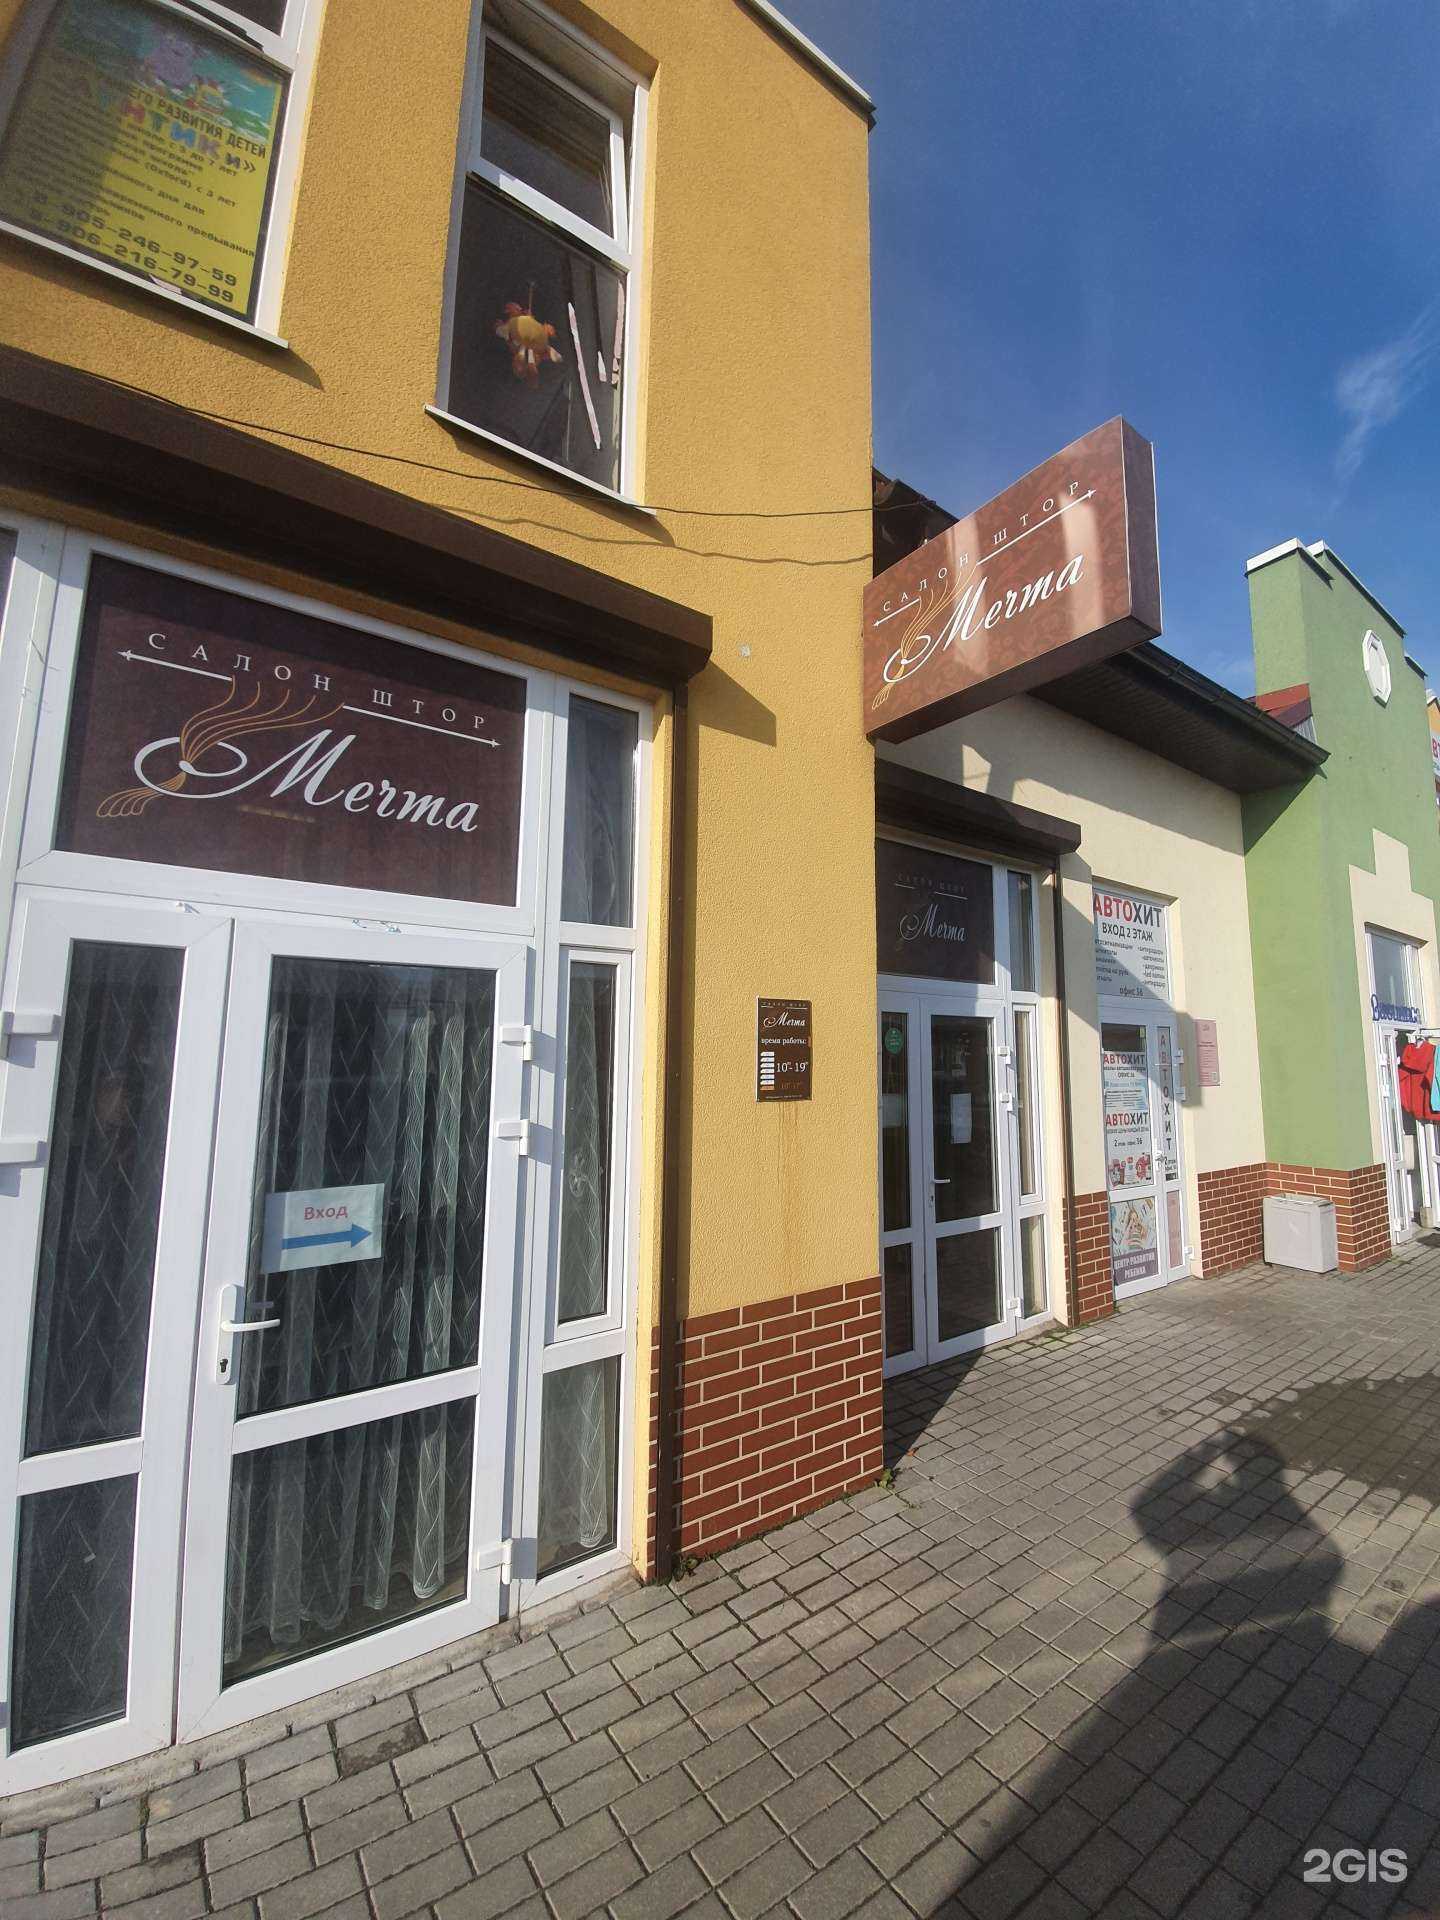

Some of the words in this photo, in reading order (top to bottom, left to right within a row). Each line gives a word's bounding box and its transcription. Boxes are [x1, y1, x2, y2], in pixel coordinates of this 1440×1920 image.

[159, 98, 223, 139] РАЗВИТИЯ
[226, 133, 266, 158] ДЕТЕЙ
[883, 553, 970, 612] САЛОН
[993, 481, 1079, 545] ШТОР
[883, 554, 1085, 683] Мечта
[148, 632, 330, 692] САЛОН
[373, 687, 486, 730] ШТОР
[134, 729, 480, 833] Мечта
[900, 903, 966, 941] Мечта
[1092, 893, 1162, 928] АВТОХИТ
[1102, 922, 1125, 940] ВХОД
[1126, 928, 1131, 938] 2
[1132, 928, 1154, 942] ЭТАЖ
[763, 1011, 805, 1028] Мечта
[1104, 1053, 1145, 1065] АВТОХИТ
[1105, 1111, 1149, 1127] АВТОХИТ
[304, 1205, 349, 1221] Вход
